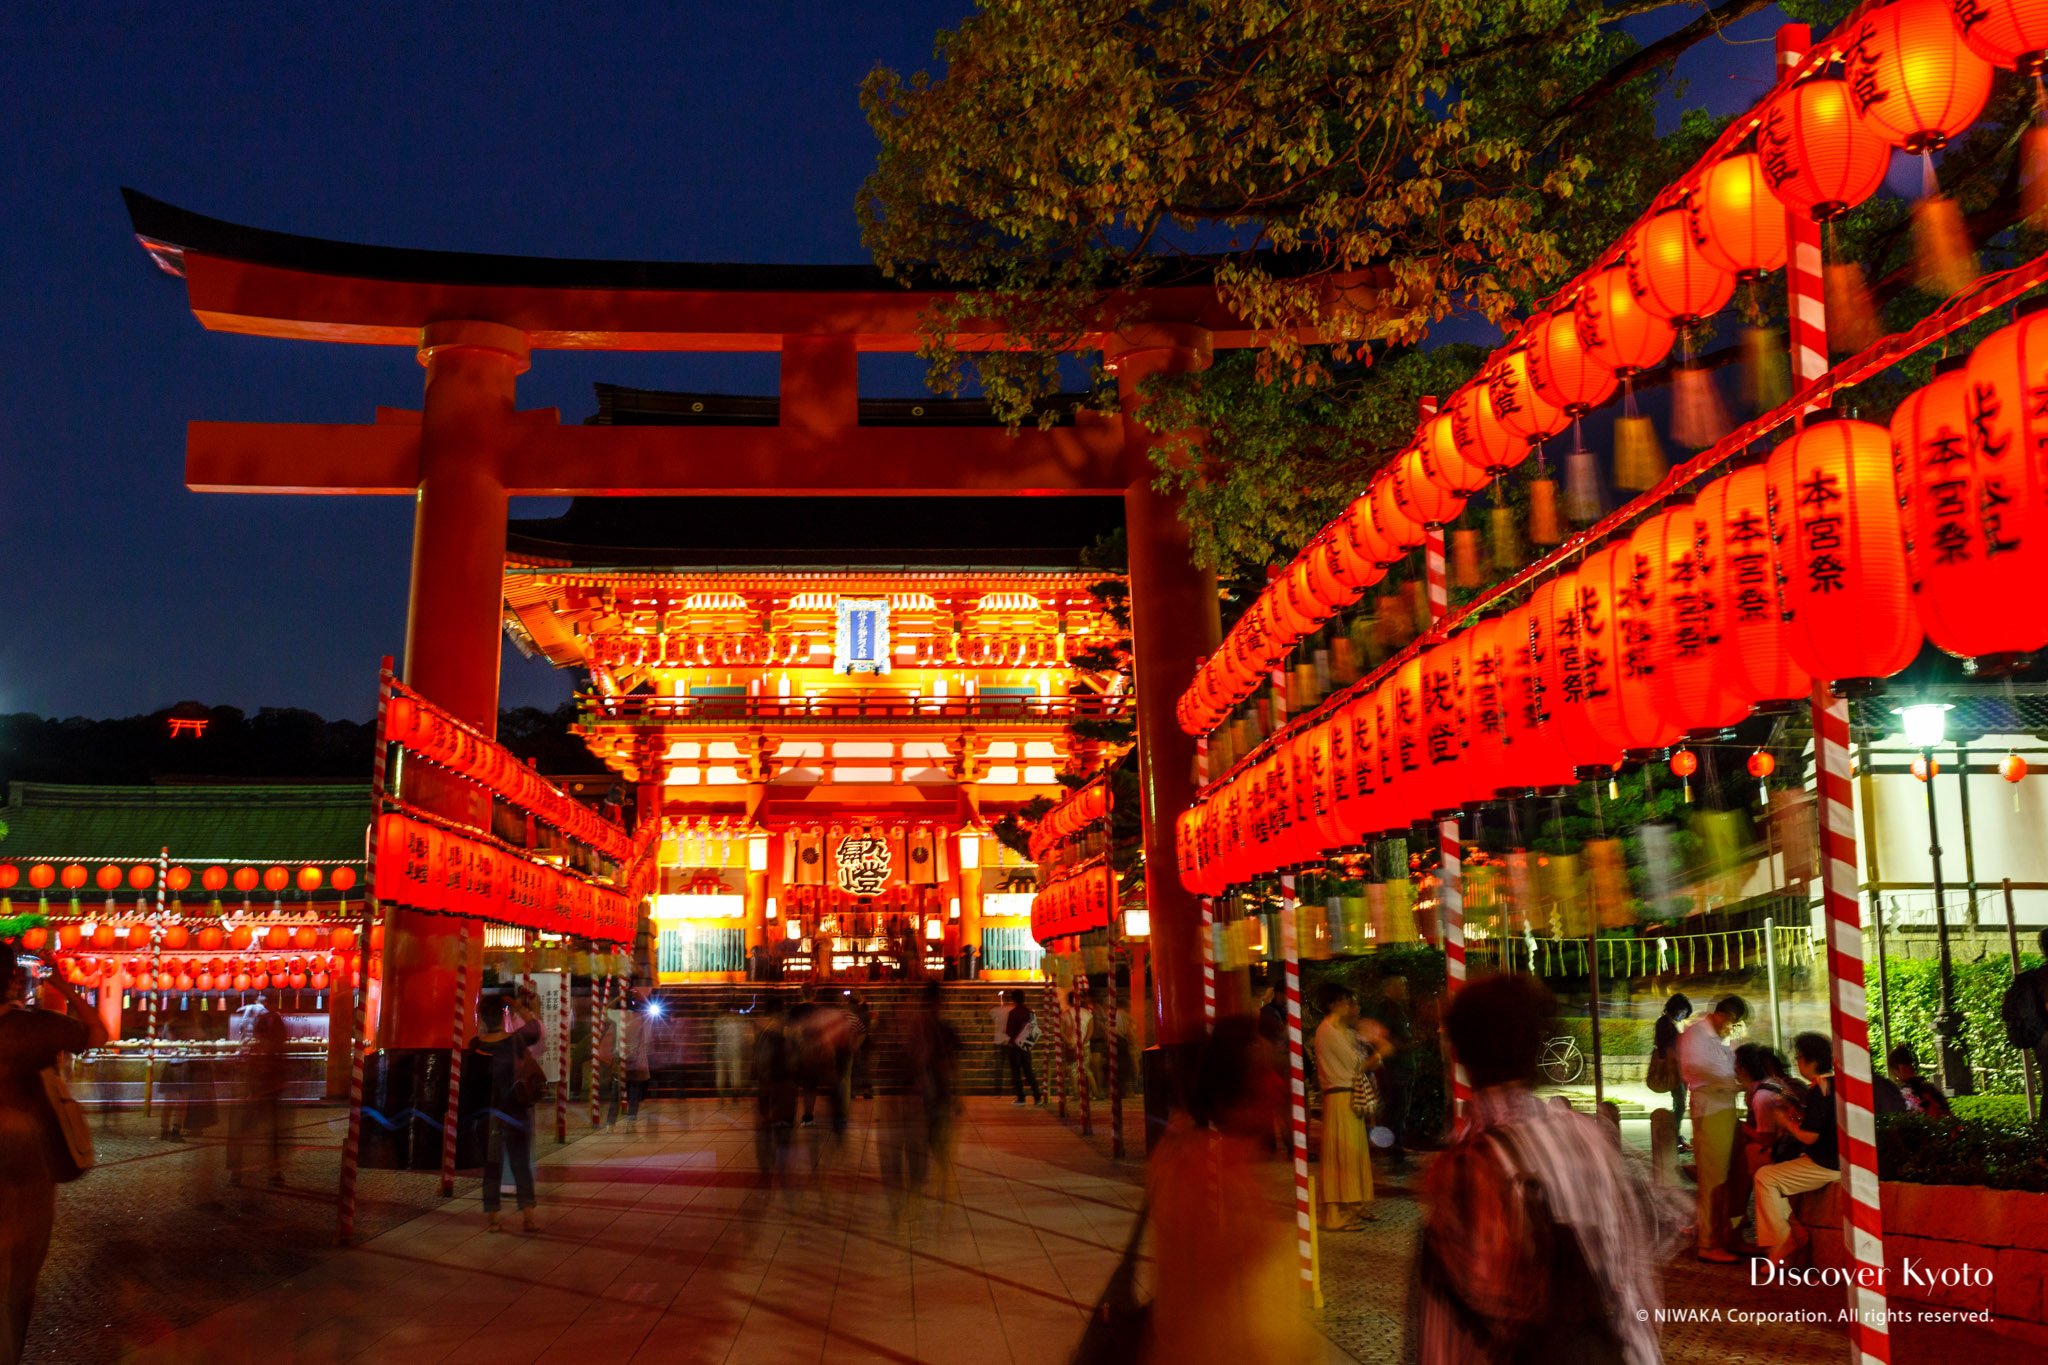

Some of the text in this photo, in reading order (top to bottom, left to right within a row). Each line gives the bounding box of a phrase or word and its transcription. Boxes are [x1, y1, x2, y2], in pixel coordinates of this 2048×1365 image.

[1803, 469, 1846, 594] 本宮祭
[1928, 432, 1972, 566] 本宮祭
[1730, 510, 1768, 622] 本宮祭
[1558, 611, 1583, 703] 本宮祭
